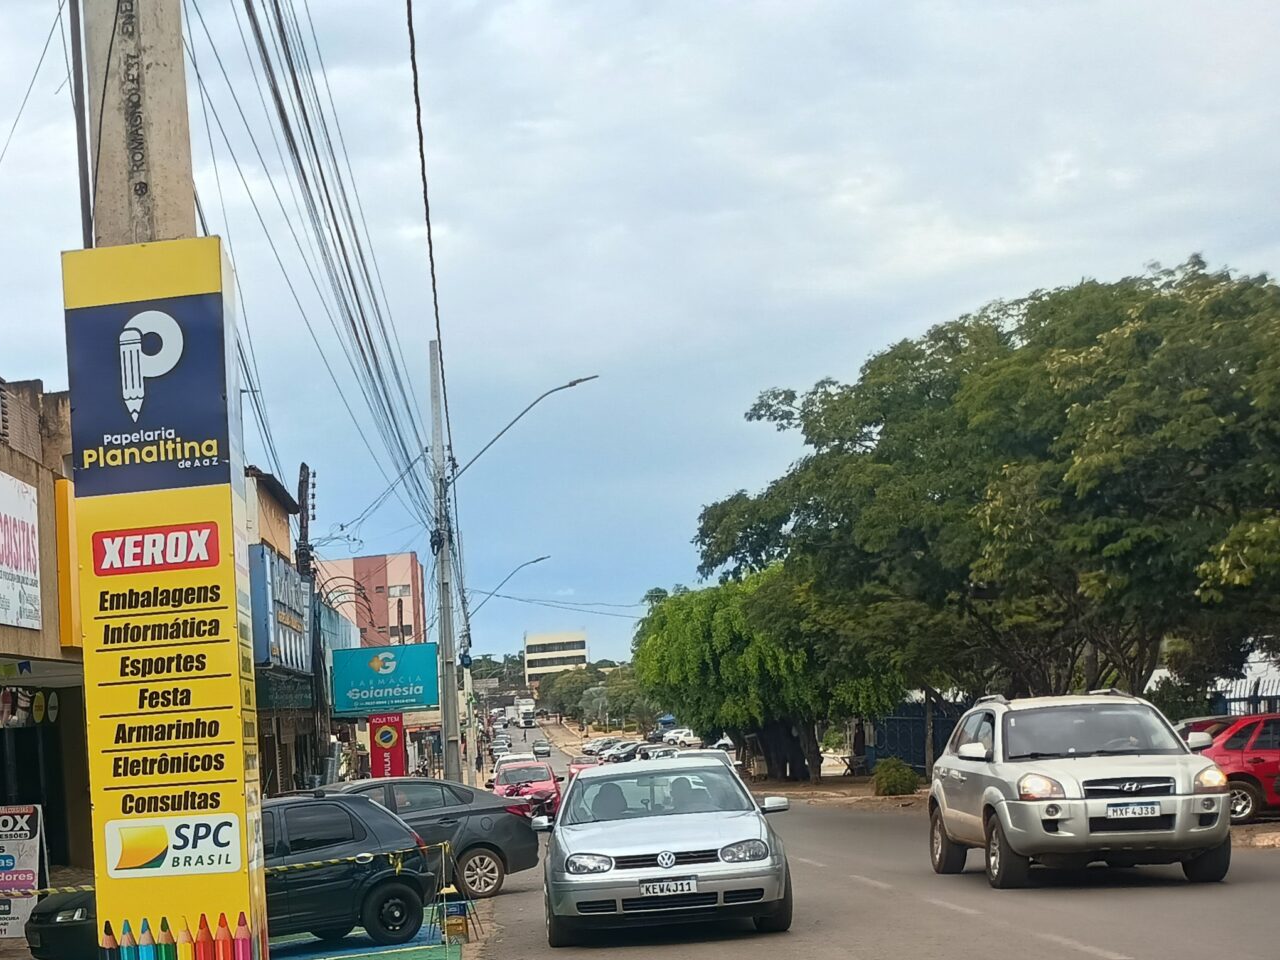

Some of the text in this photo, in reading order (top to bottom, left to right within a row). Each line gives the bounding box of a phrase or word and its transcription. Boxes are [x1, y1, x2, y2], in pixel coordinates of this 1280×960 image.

[103, 426, 176, 446] Papelaria
[83, 437, 218, 470] Planaltina
[177, 460, 191, 469] de
[193, 459, 201, 467] A
[202, 459, 211, 467] a
[100, 528, 211, 570] XEROX
[99, 584, 221, 612] Embalagens
[102, 617, 221, 645] Informática
[119, 653, 207, 678] Esportes
[138, 686, 192, 710] Festa
[348, 683, 424, 700] Goianésia
[114, 718, 220, 744] Armarinho
[112, 752, 225, 778] Eletrônicos
[121, 790, 221, 815] Consultas
[172, 820, 233, 851] SPC
[171, 853, 232, 868] BRASIL
